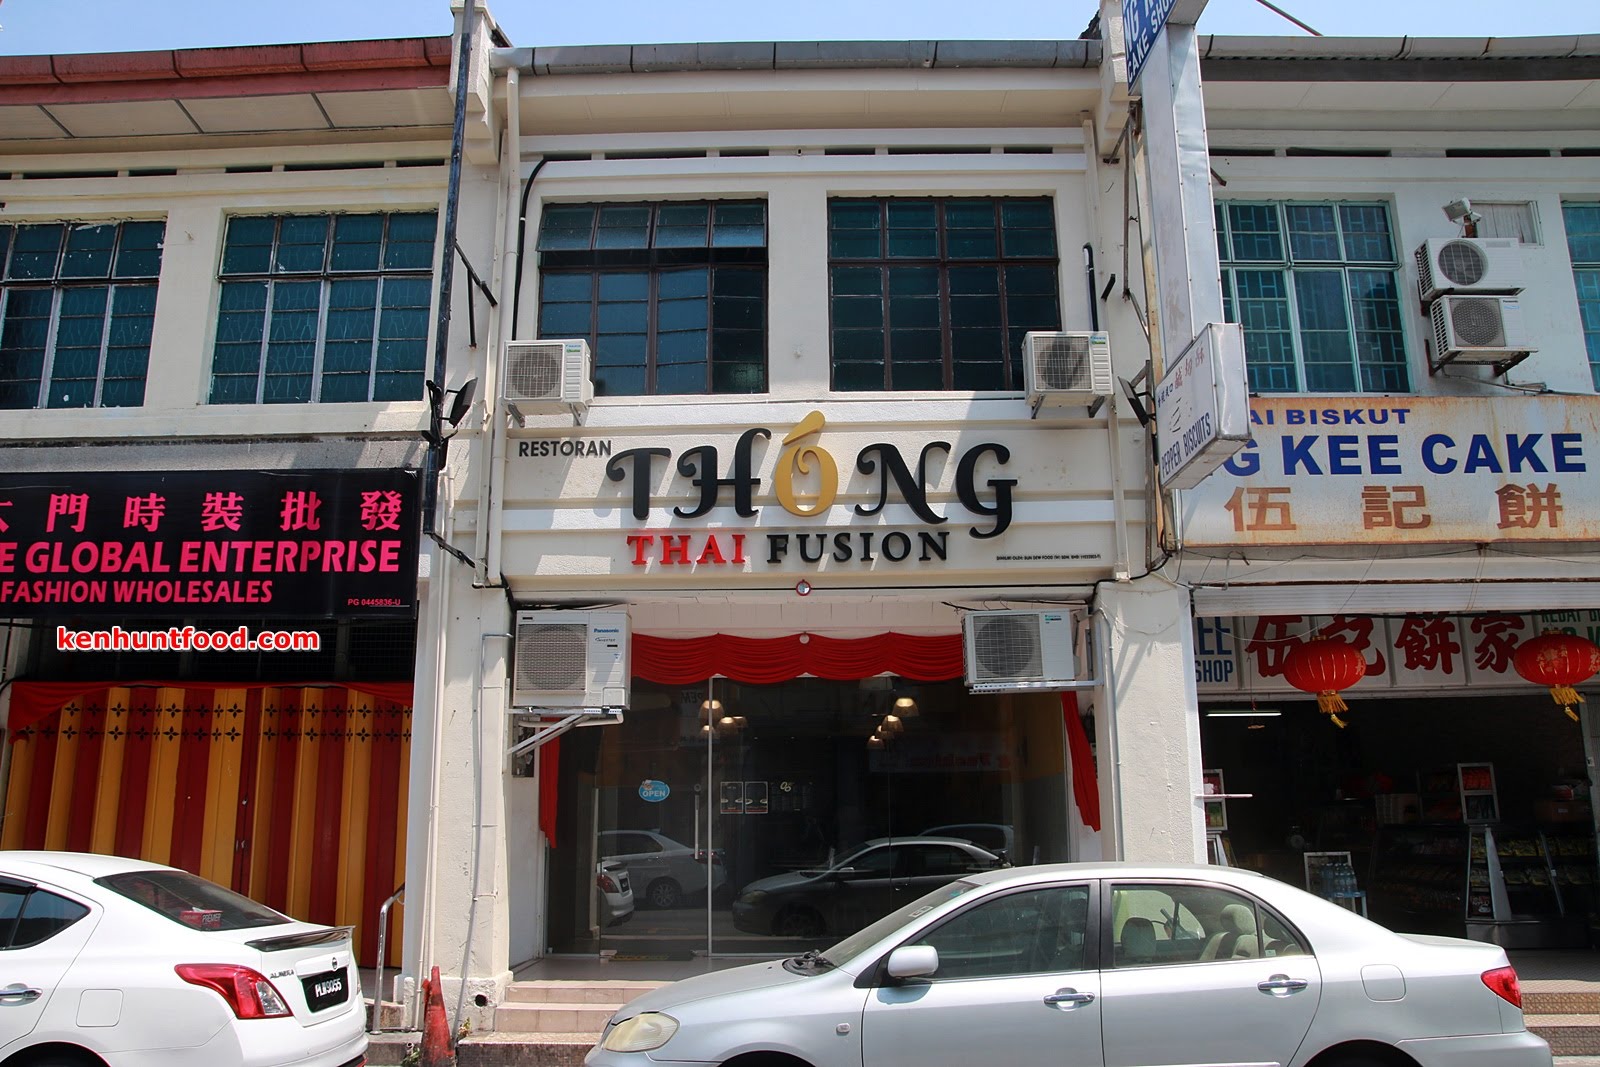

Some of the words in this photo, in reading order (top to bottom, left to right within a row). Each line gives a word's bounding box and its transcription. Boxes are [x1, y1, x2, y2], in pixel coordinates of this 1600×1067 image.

[1127, 28, 1150, 83] CAKE
[1151, 0, 1174, 33] SHO
[1286, 408, 1411, 425] BISKUT
[519, 440, 612, 457] RESTORAN
[1161, 441, 1182, 479] PEPPER
[1182, 412, 1211, 458] BISCUITS
[1281, 434, 1402, 475] KEE
[1420, 433, 1587, 474] CAKE
[1224, 482, 1563, 532] 伍記餅
[25, 541, 171, 574] GLOBAL
[180, 540, 402, 573] ENTERPRISE
[627, 534, 746, 565] THAI
[766, 531, 950, 564] FUSION
[1, 580, 107, 604] FASHION
[113, 580, 273, 604] WHOLESALES
[347, 598, 360, 606] PG
[642, 790, 666, 798] OPEN
[202, 913, 222, 924] PREMIER
